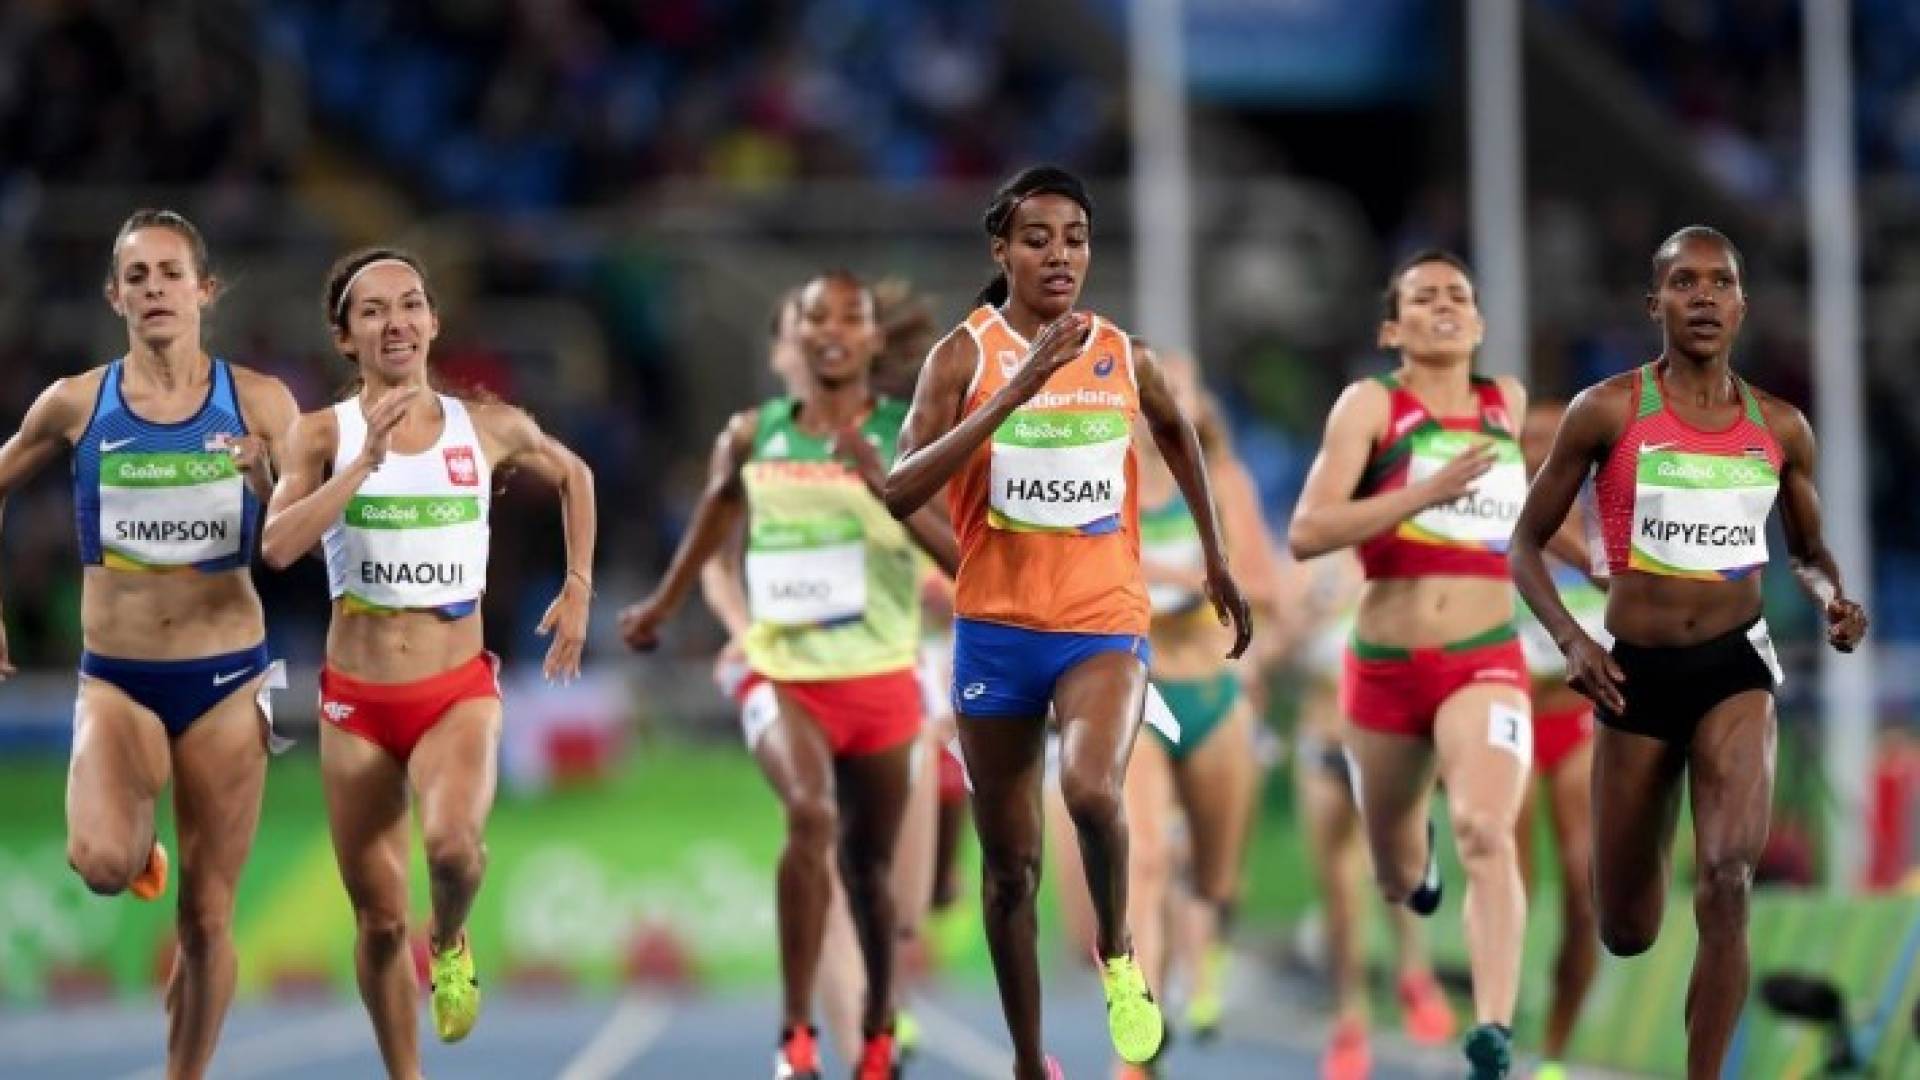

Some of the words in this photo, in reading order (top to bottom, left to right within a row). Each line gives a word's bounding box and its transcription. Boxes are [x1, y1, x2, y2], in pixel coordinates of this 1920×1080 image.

[1006, 478, 1111, 502] HASSAN
[115, 520, 228, 541] SIMPSON
[1641, 514, 1756, 546] KIPYEGON
[361, 561, 463, 584] ENAOUI
